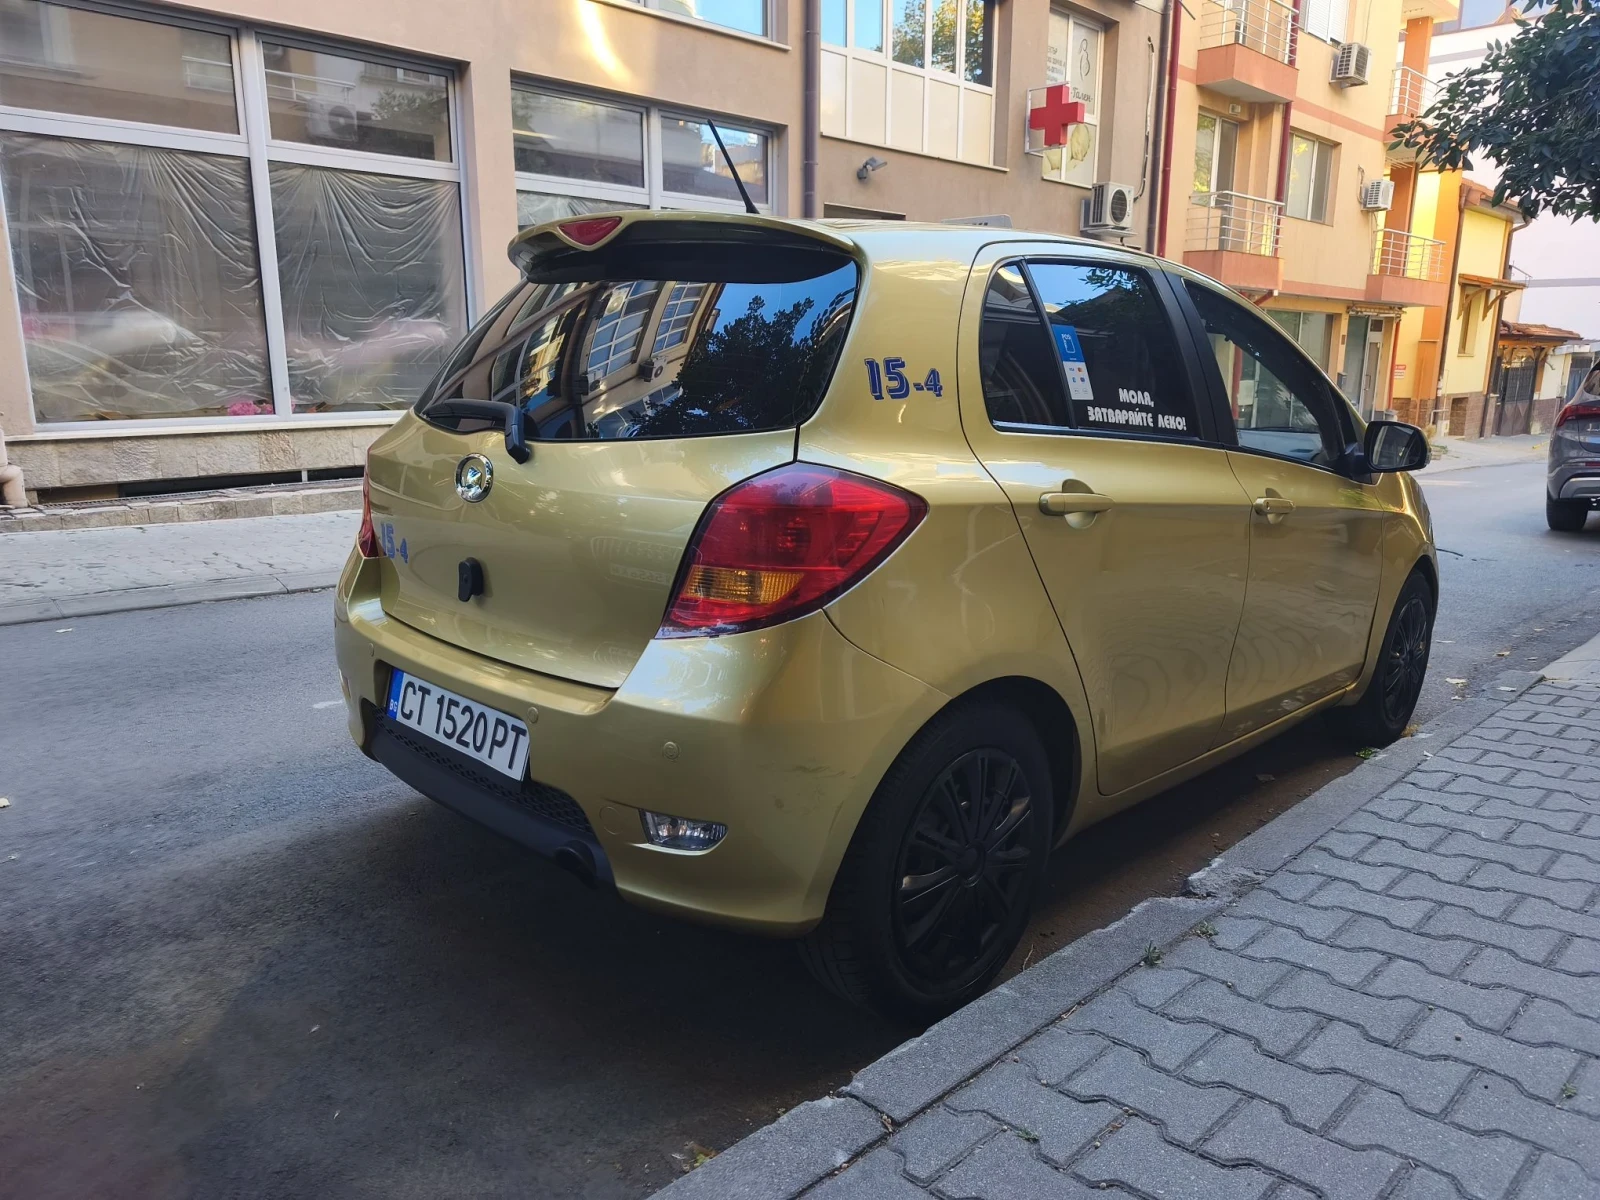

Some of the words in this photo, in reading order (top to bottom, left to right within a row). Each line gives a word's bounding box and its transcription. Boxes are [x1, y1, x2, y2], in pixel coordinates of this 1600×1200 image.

[864, 357, 943, 400] 15-4
[1119, 388, 1154, 407] МОЛЯ,
[1087, 406, 1153, 427] ЗАТВАРЯЙТЕ
[1158, 413, 1187, 431] ЛЕКО!
[389, 699, 398, 712] BG
